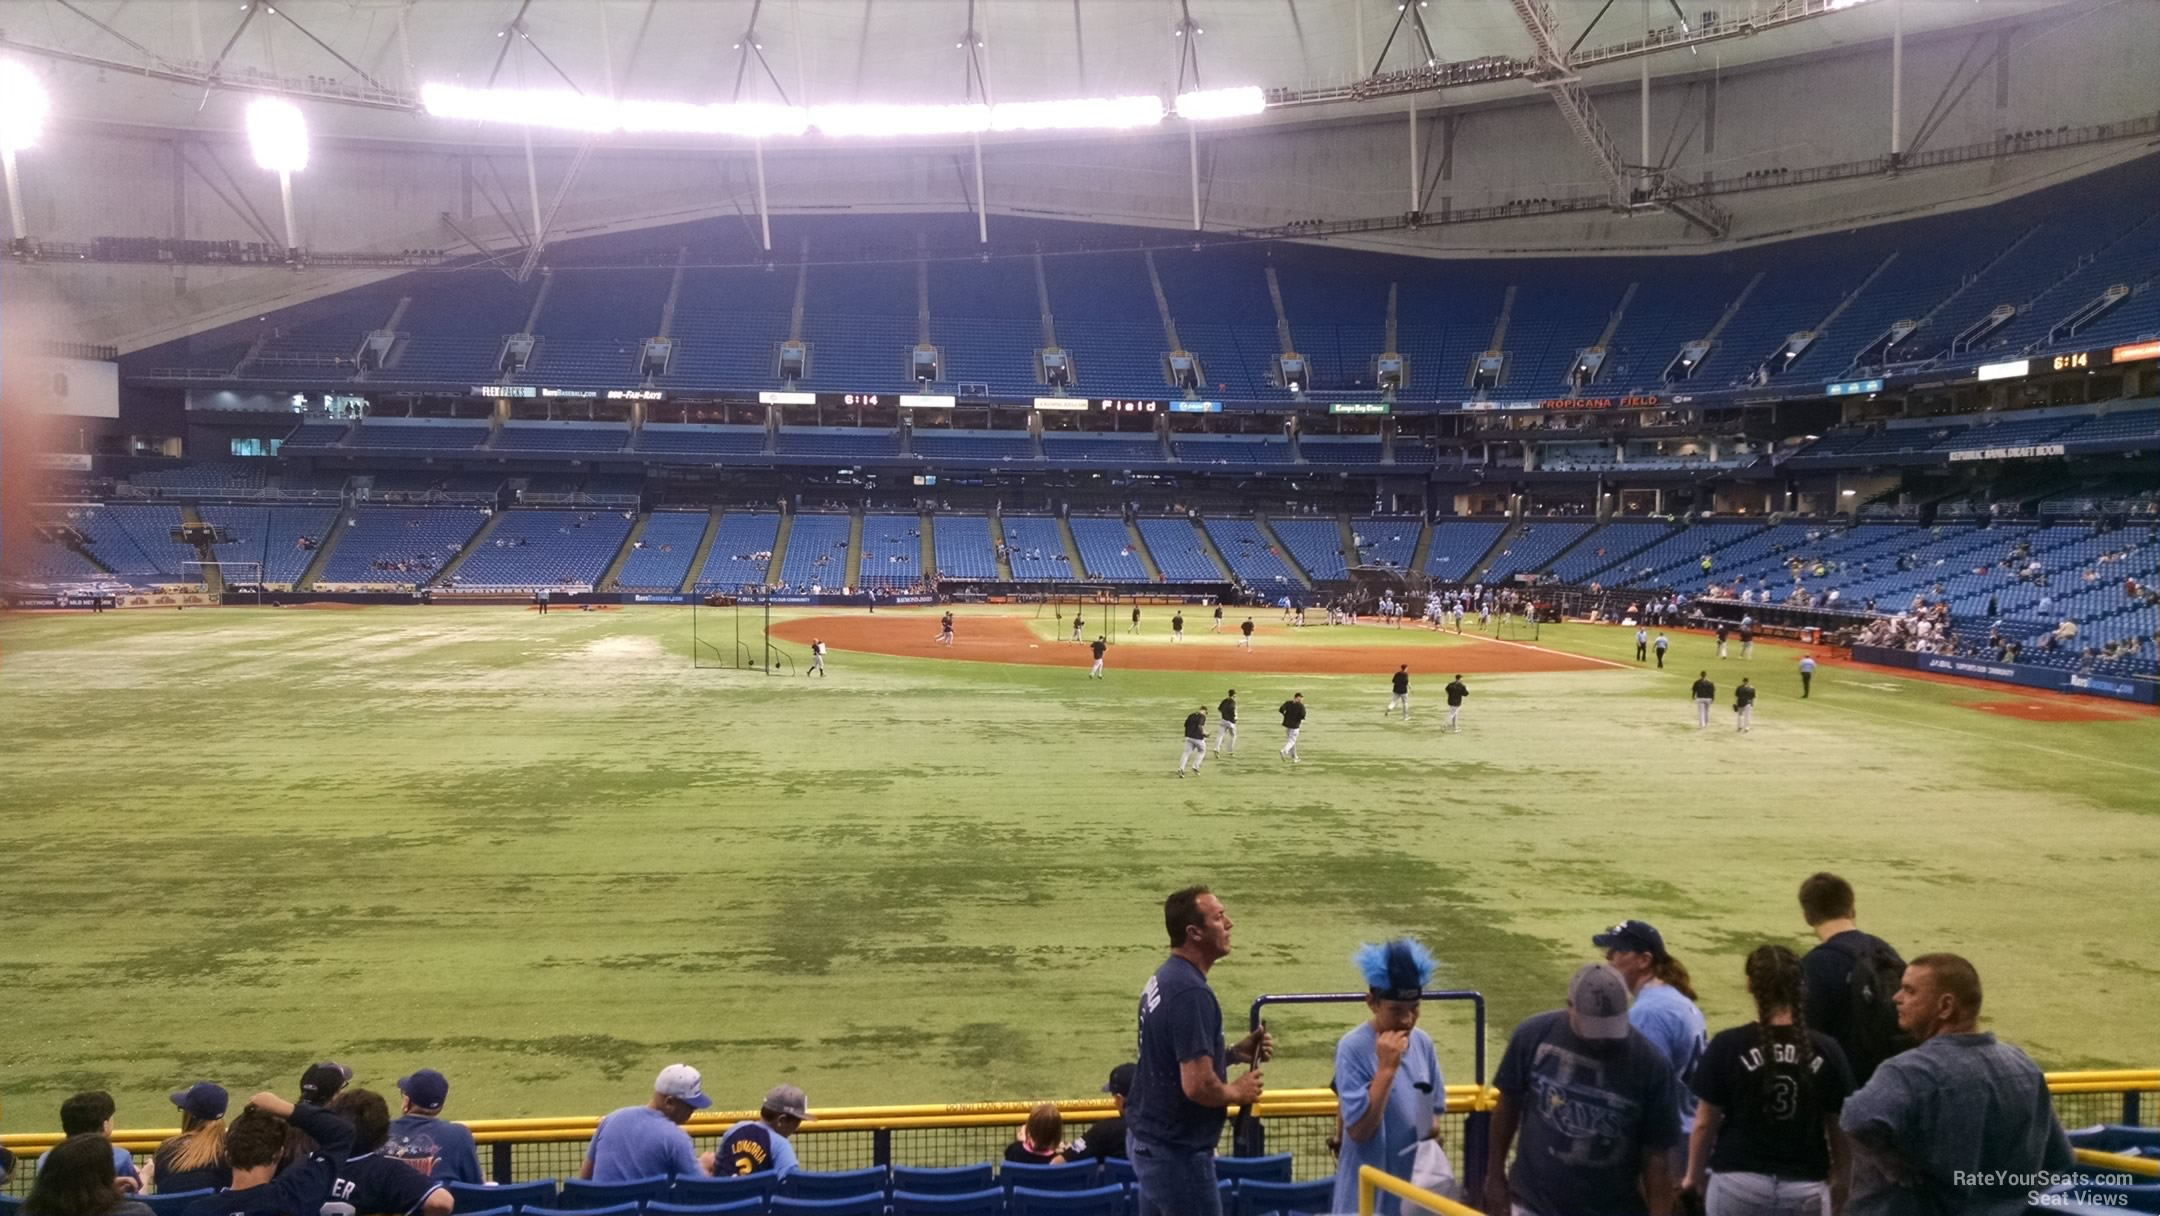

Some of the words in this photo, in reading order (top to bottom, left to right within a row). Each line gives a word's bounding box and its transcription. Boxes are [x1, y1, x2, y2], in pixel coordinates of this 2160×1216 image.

[2053, 352, 2088, 370] 6:14
[482, 386, 500, 397] FLEX
[844, 394, 878, 406] 6:14
[1101, 399, 1156, 411] Field
[1540, 398, 1612, 409] TROPICANA
[1620, 395, 1658, 407] FIELD
